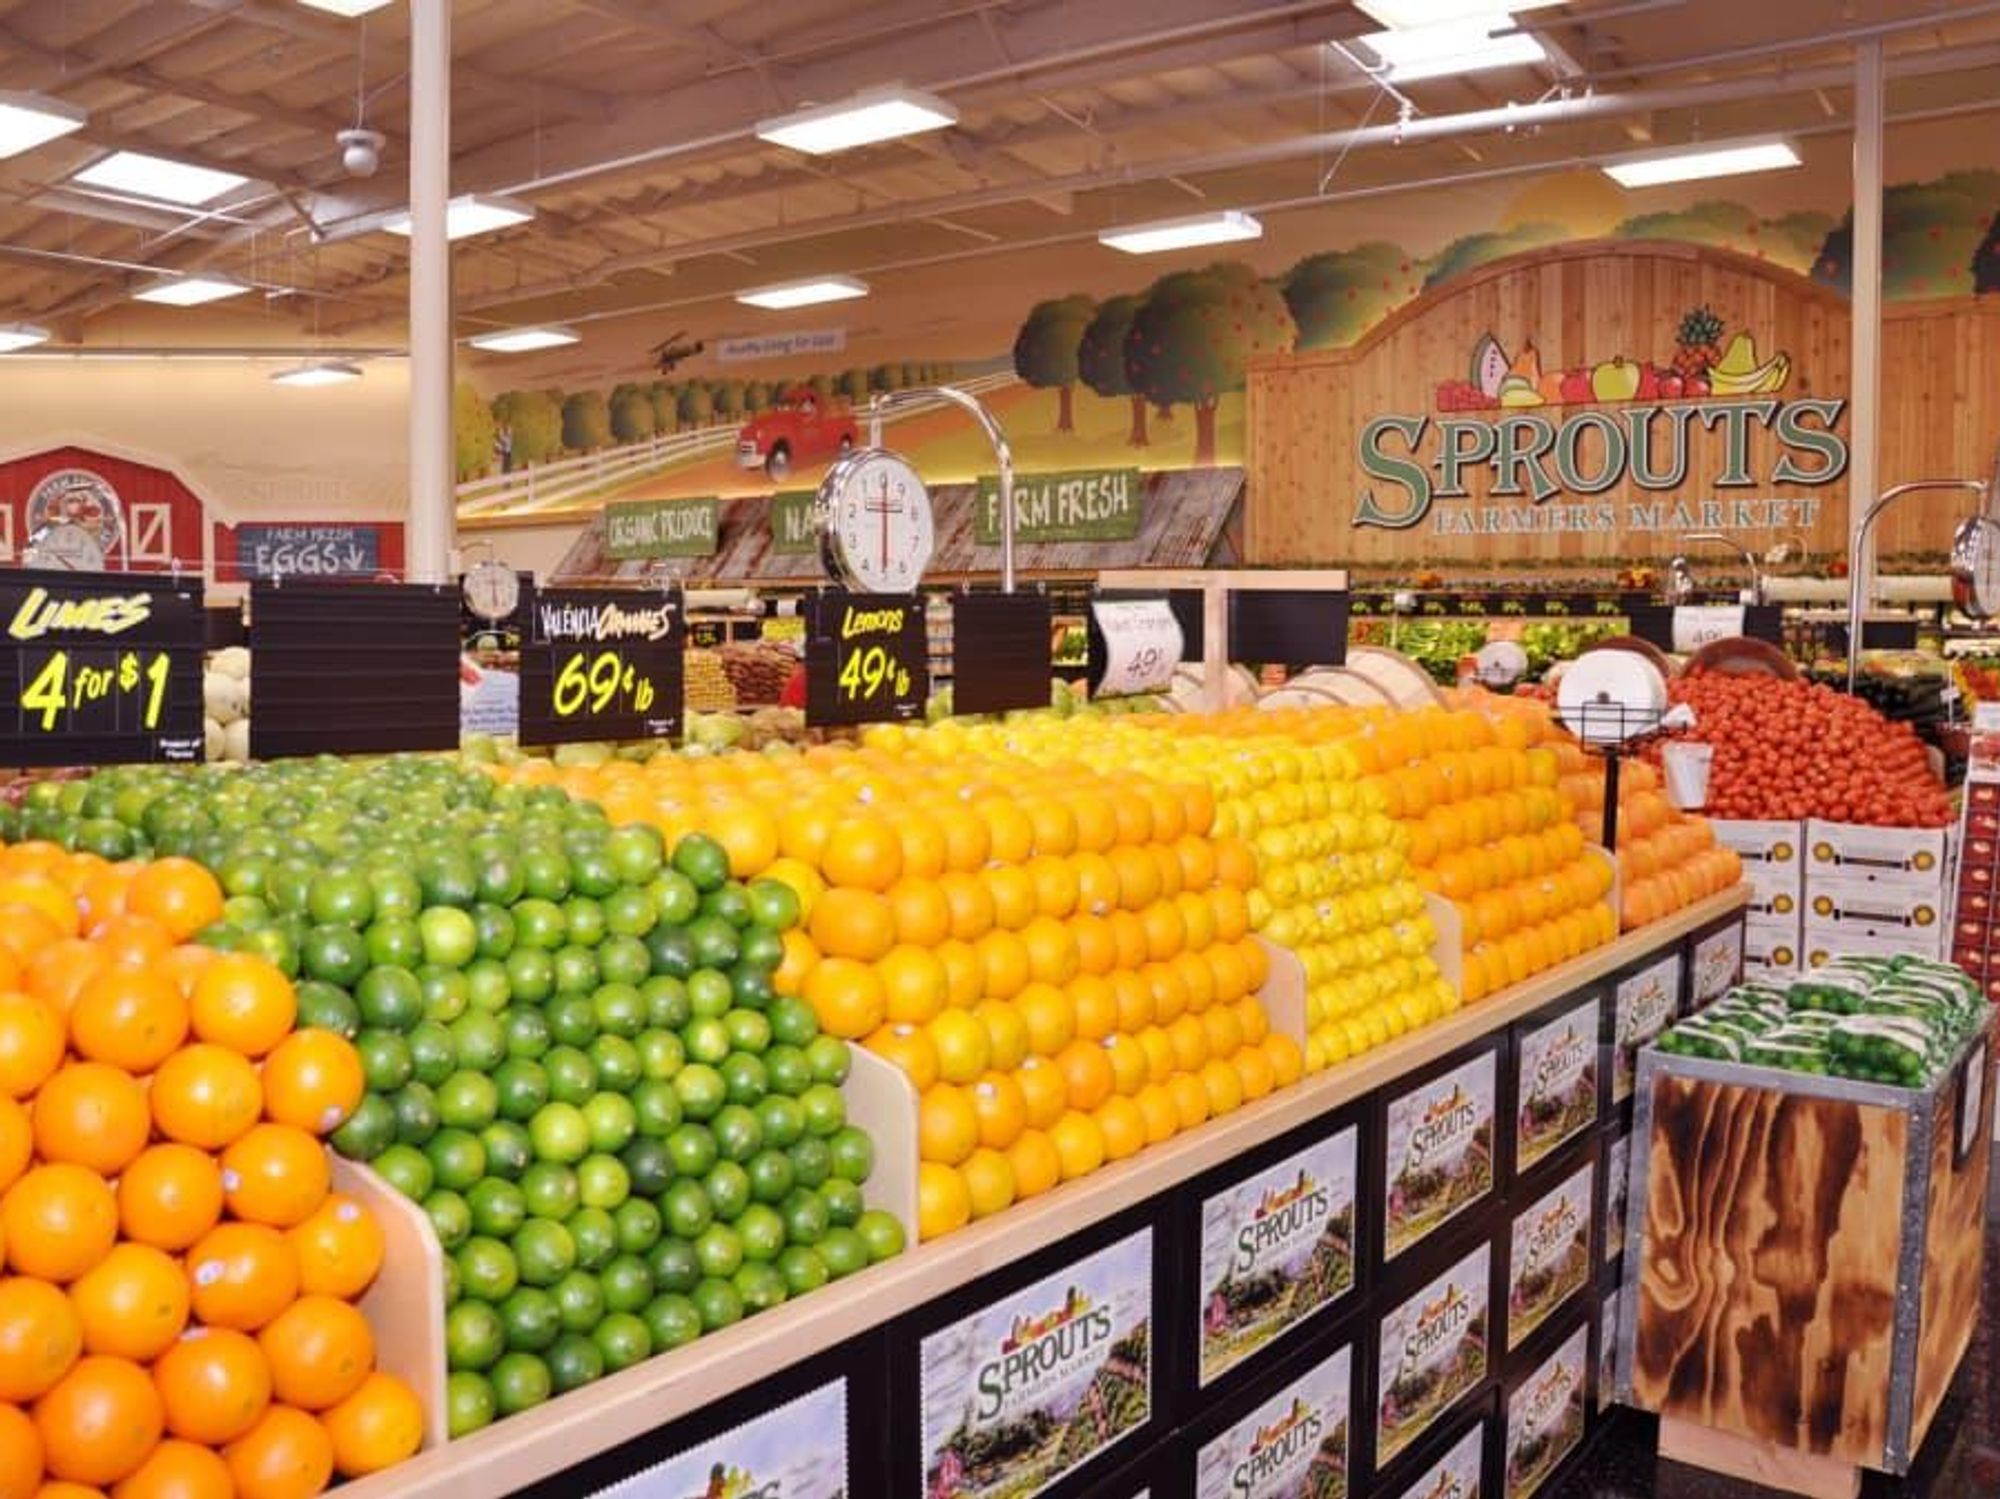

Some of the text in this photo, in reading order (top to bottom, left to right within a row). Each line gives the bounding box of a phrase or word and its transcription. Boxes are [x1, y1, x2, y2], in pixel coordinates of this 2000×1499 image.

[1352, 399, 1848, 528] SPROUTS
[988, 474, 1128, 533] FRM FRESH
[1433, 498, 1822, 536] FARMERS MARKET
[255, 543, 341, 574] EGGS
[21, 651, 67, 732] 4
[73, 666, 115, 710] for
[634, 677, 655, 712] lb
[895, 667, 911, 697] lb
[1411, 1101, 1475, 1168] SPROUTS
[1237, 1186, 1329, 1273] SPROUTS
[977, 1304, 1112, 1421] SPROUTS
[1405, 1293, 1470, 1374] SPROUTS
[1233, 1409, 1322, 1499] SPROUTS
